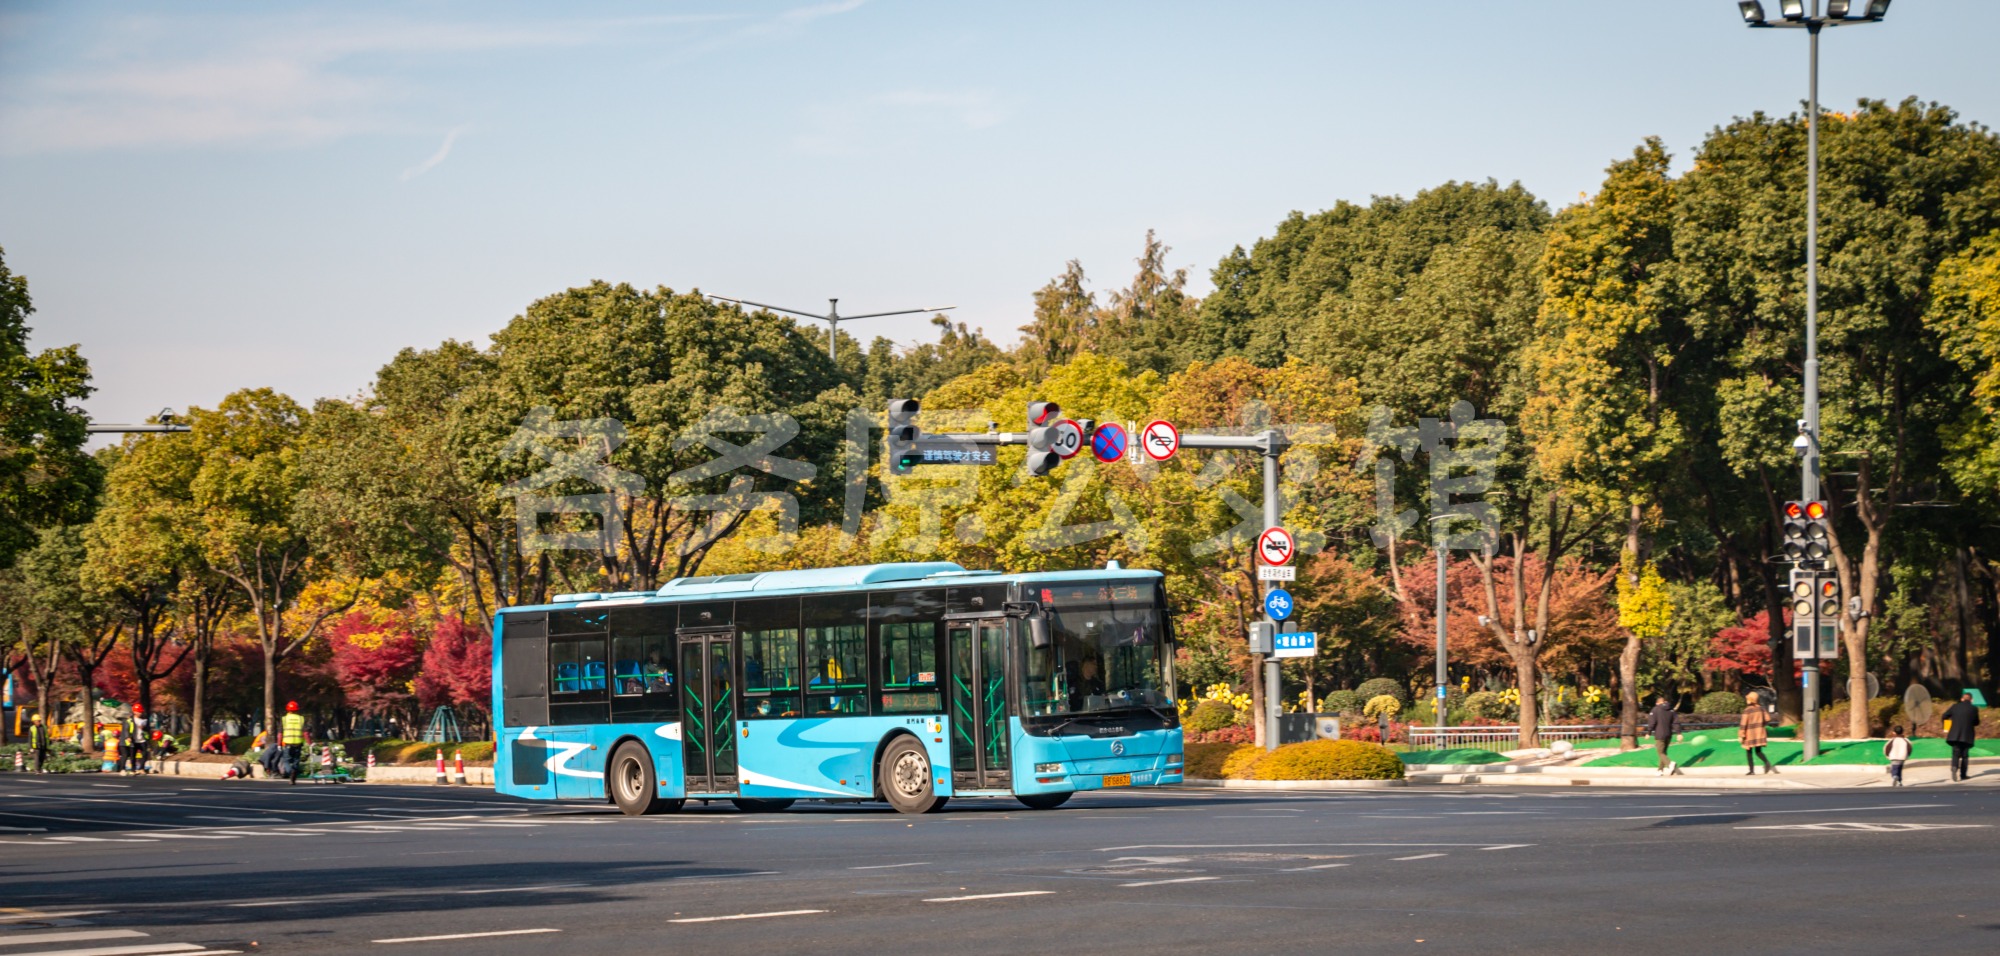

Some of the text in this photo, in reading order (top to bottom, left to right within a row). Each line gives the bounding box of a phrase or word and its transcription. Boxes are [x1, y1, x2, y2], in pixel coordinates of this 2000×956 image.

[923, 449, 992, 462] 谨慎驾驶才安全
